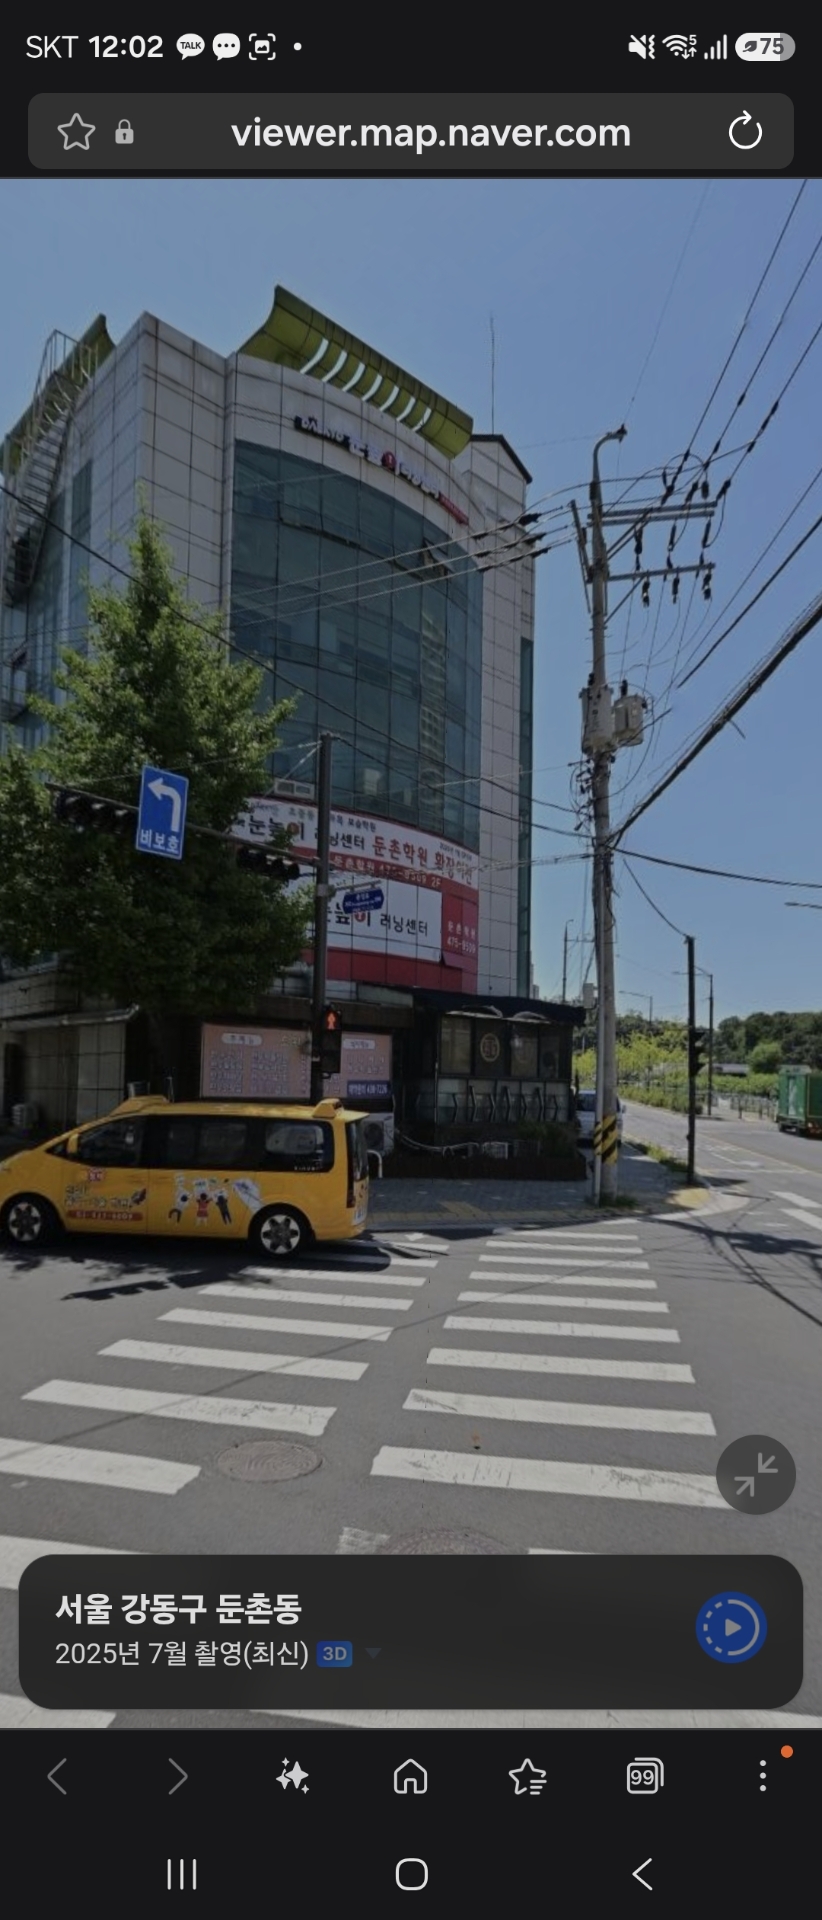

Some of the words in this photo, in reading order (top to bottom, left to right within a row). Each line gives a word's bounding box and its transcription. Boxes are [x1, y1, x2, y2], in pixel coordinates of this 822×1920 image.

[140, 828, 180, 854] 비보호
[371, 835, 428, 868] 둔촌학원
[430, 876, 442, 889] 2F
[379, 912, 429, 938] 러닝센터
